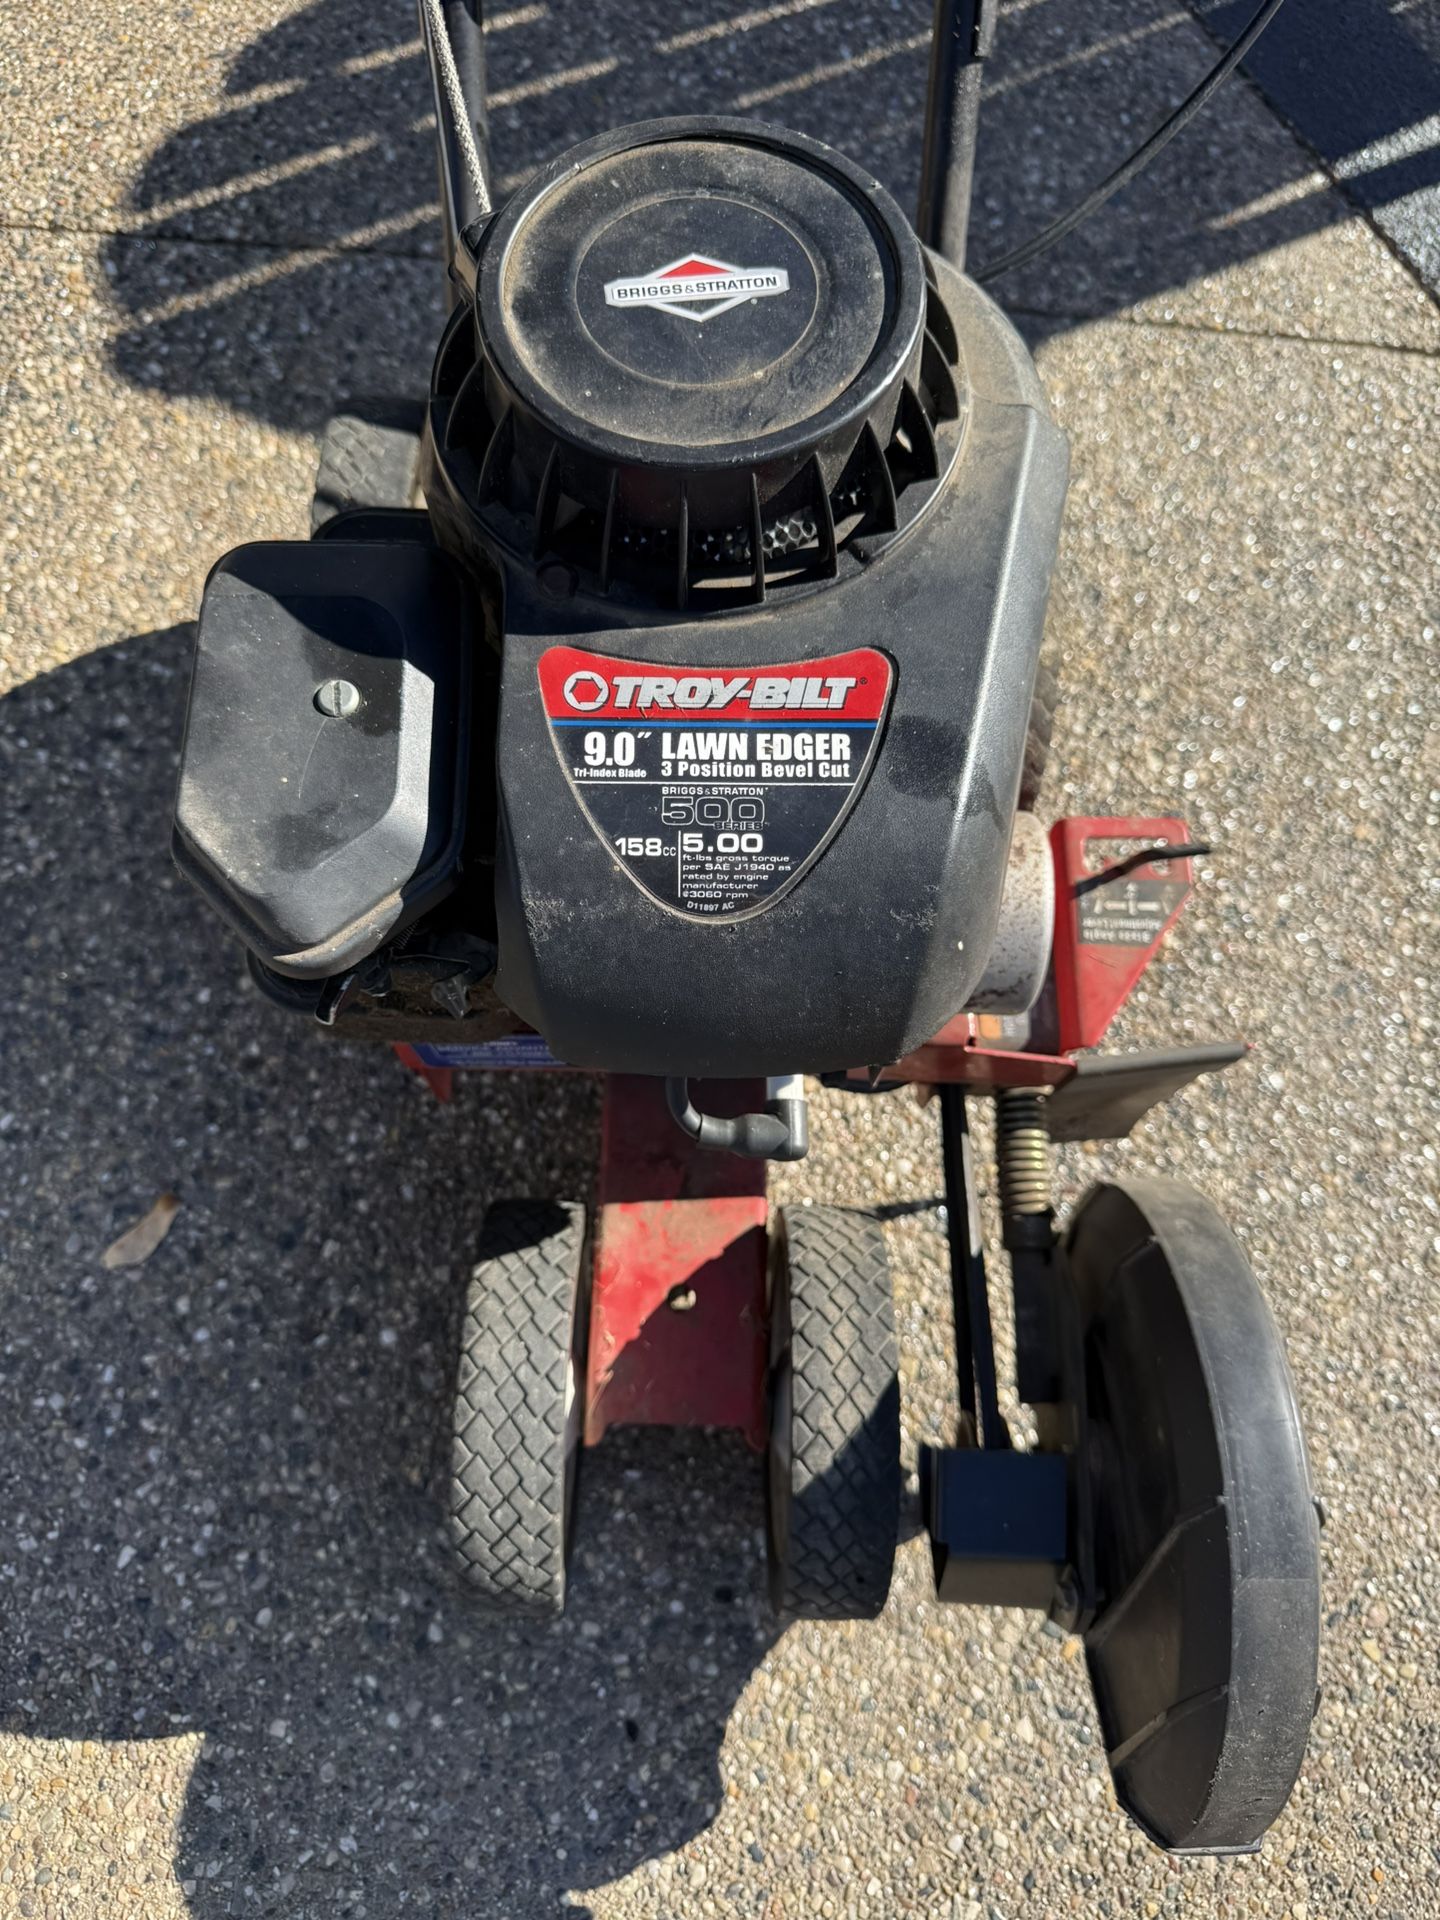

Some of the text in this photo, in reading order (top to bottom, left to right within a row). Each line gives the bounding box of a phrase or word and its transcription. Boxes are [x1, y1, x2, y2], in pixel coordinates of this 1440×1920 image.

[612, 677, 857, 709] TROY-BILT
[662, 732, 748, 760] LAWN
[756, 733, 851, 761] EDGER
[573, 767, 647, 778] Tri-Index Blade
[661, 761, 851, 778] 3 Position Bevel Cut
[662, 797, 765, 826] 500
[713, 822, 764, 831] SERIES
[683, 833, 763, 853] 5.00
[716, 856, 748, 864] gross
[752, 855, 790, 864] torque
[683, 864, 701, 873] per
[705, 863, 731, 871] SAE
[734, 863, 775, 872] J1940
[683, 873, 769, 883] rated by engine
[726, 892, 748, 900] rpm
[687, 901, 735, 911] D11897 AC
